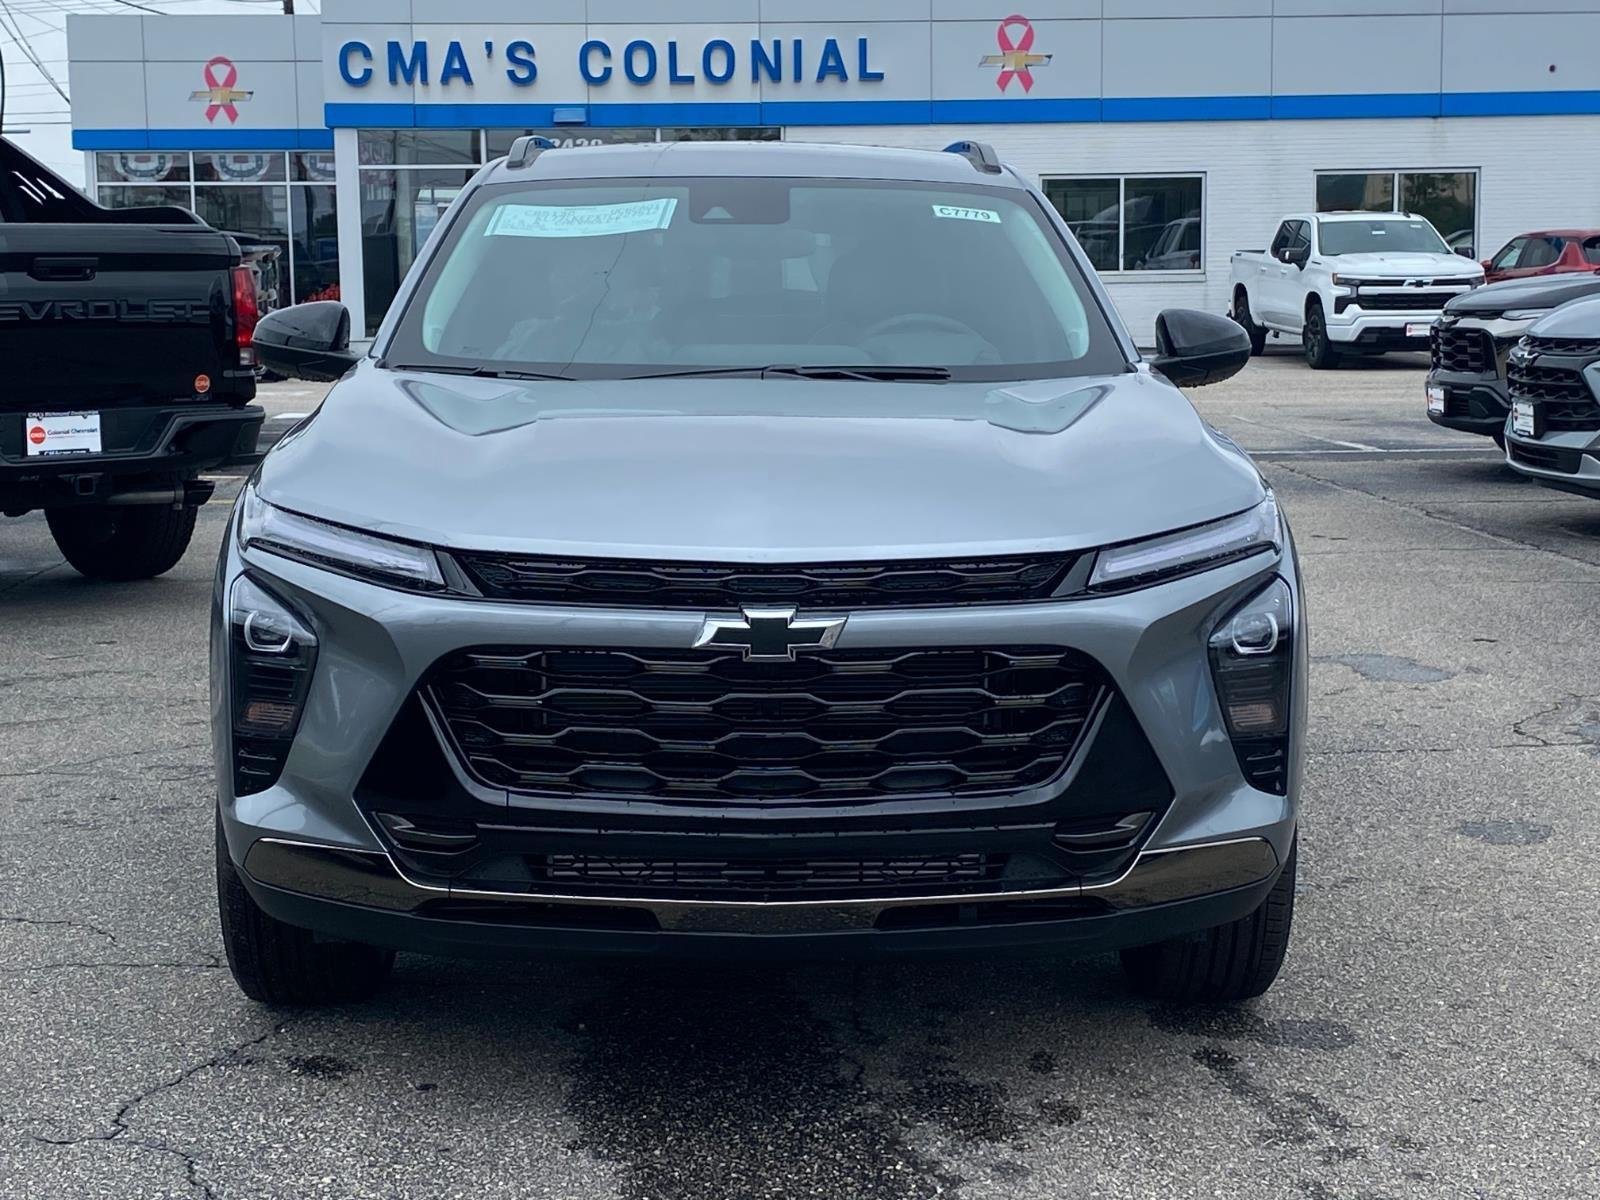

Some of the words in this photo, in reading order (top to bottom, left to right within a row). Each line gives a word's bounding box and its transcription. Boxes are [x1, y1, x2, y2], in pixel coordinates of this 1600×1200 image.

[339, 41, 538, 87] CMA'S
[579, 38, 884, 85] COLONIAL
[940, 207, 990, 220] C7779
